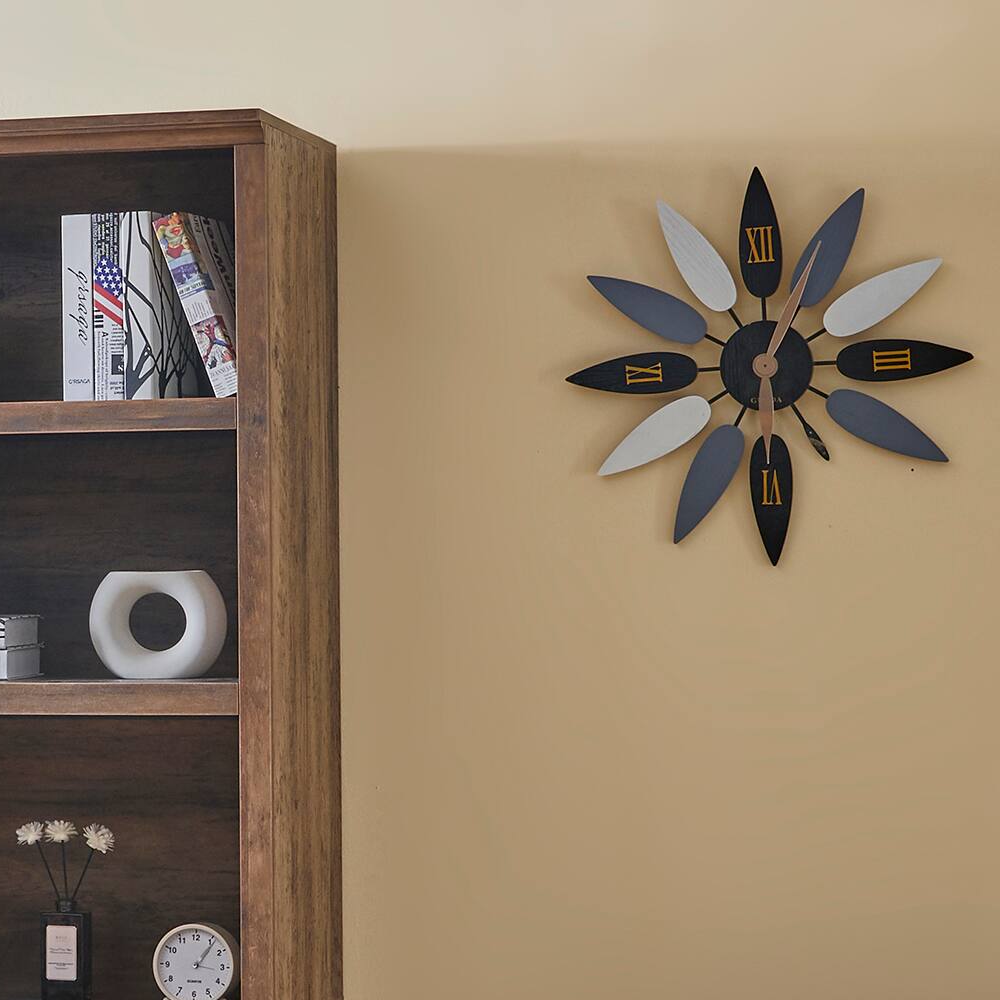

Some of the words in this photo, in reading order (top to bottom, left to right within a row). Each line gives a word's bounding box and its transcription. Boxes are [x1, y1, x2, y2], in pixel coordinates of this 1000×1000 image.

[745, 225, 775, 264] XII
[872, 348, 911, 372] III
[625, 361, 663, 385] IX
[761, 469, 782, 506] VI
[191, 990, 197, 998] 6
